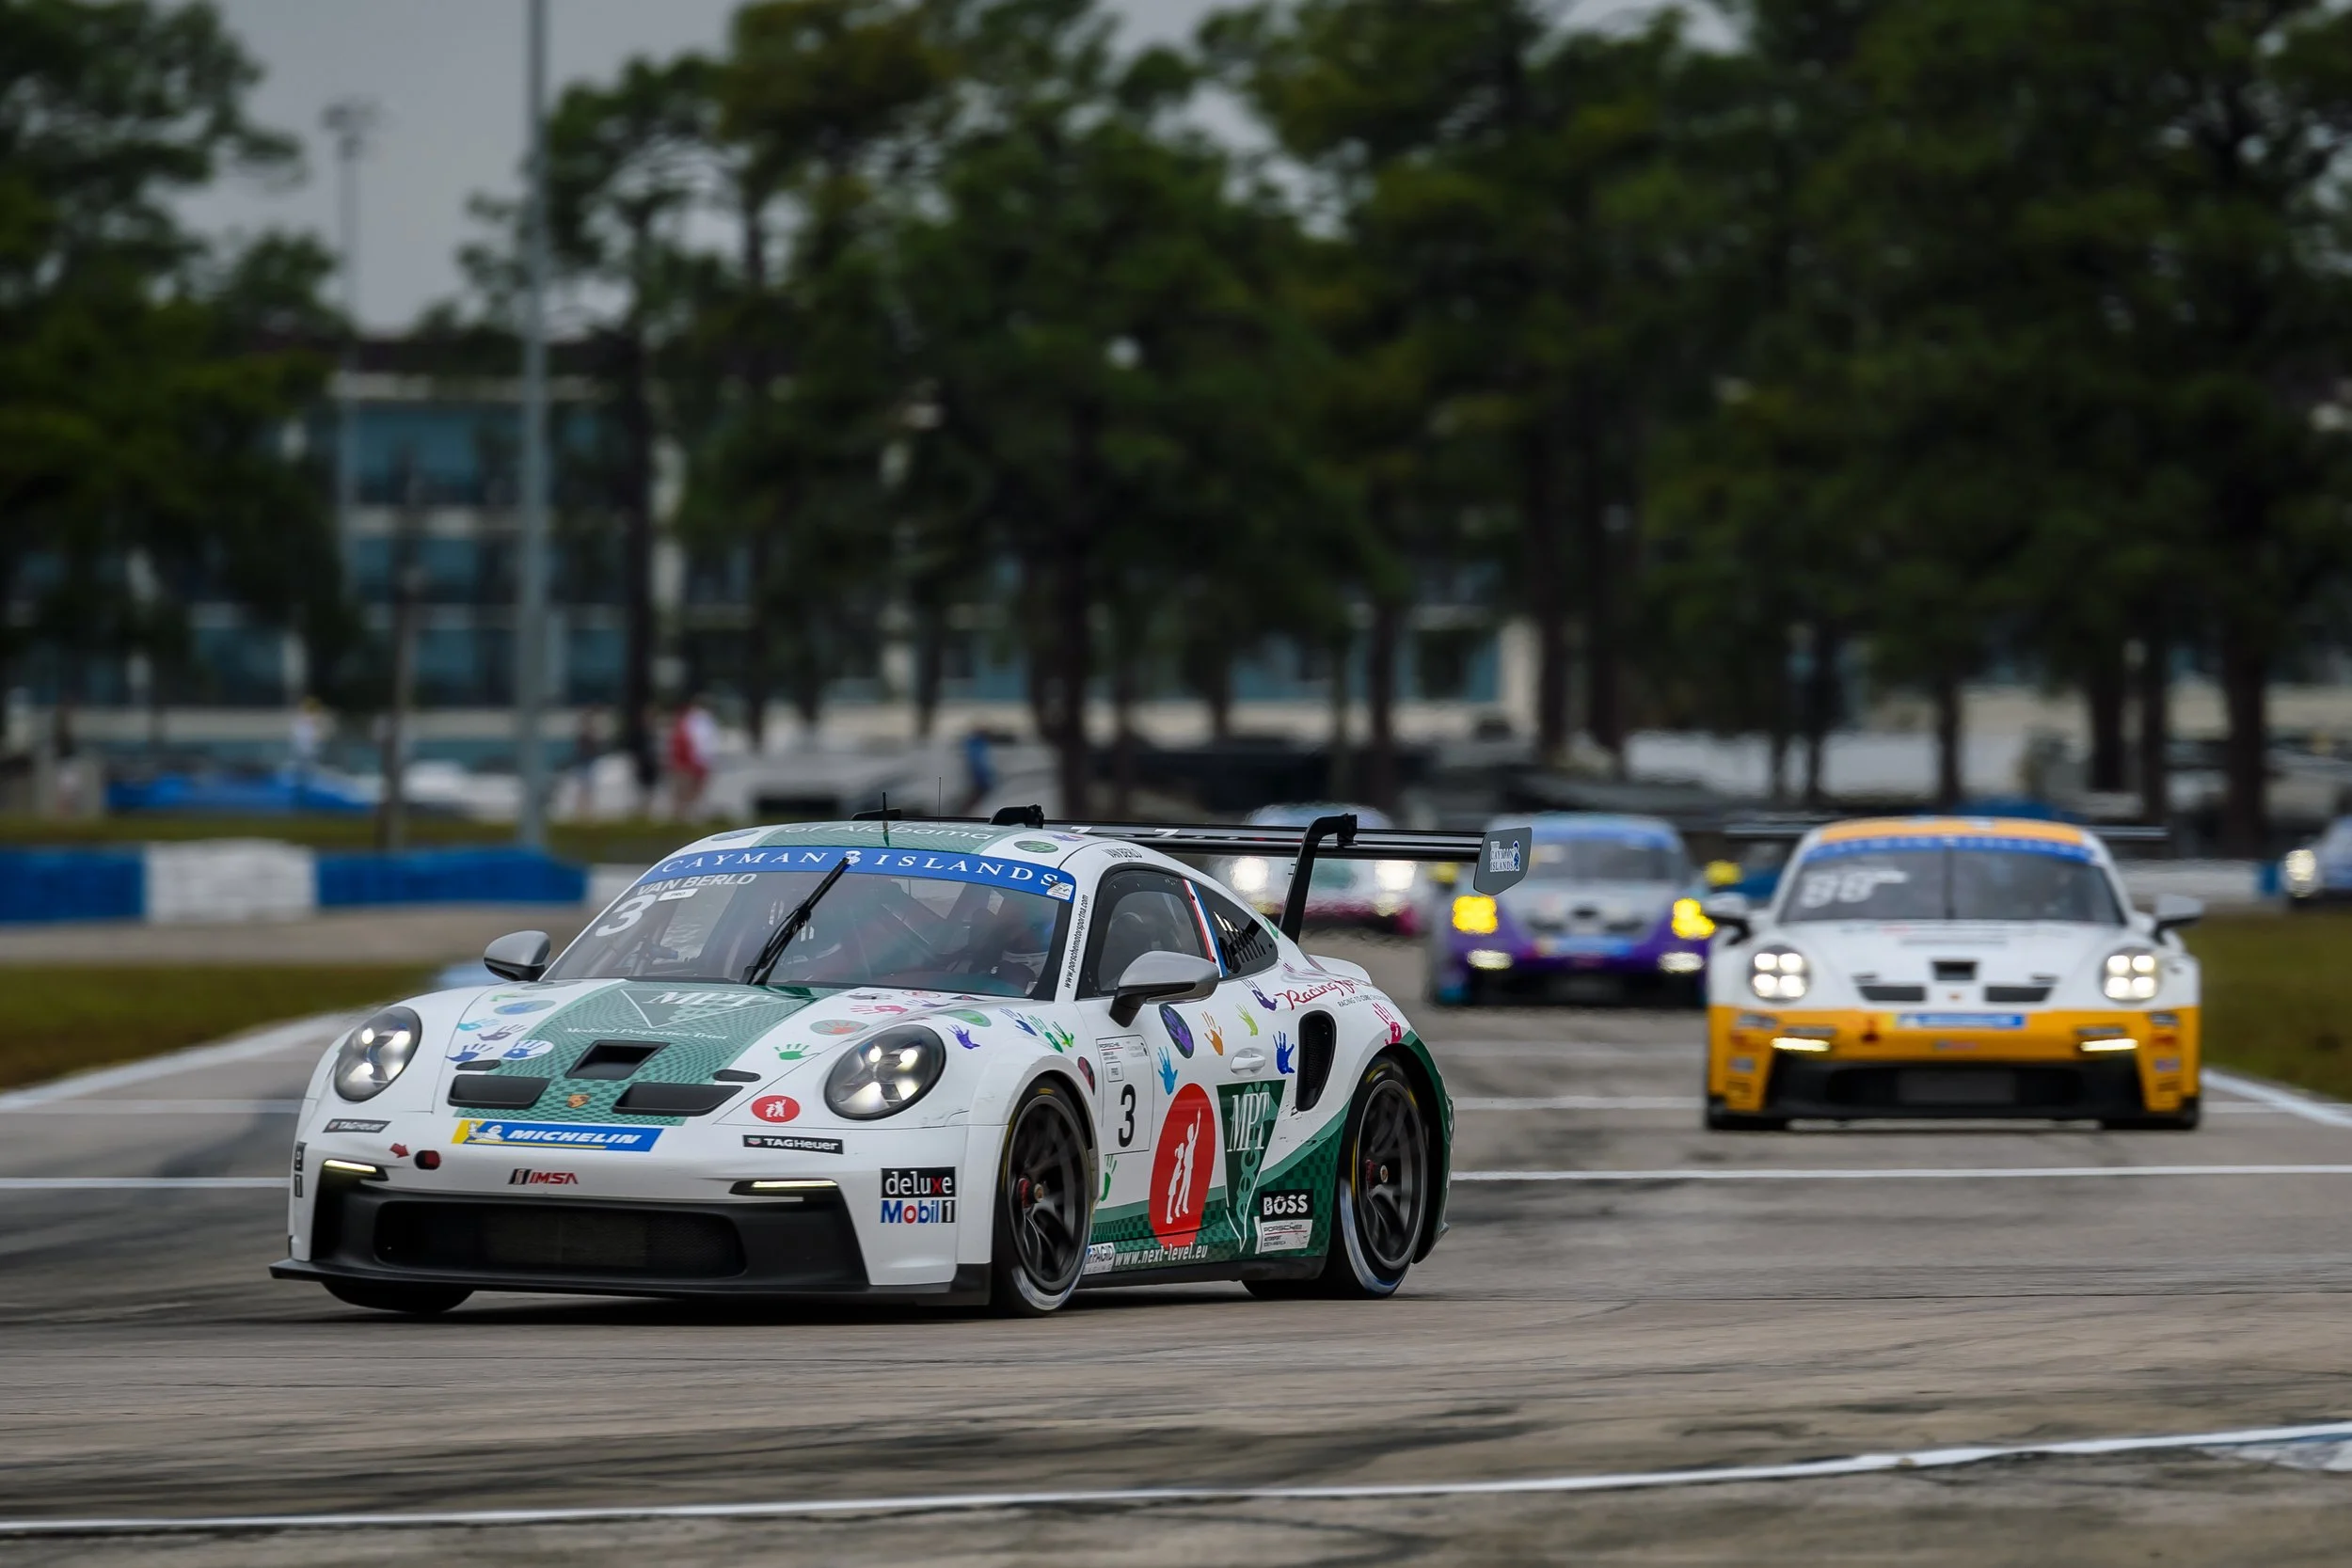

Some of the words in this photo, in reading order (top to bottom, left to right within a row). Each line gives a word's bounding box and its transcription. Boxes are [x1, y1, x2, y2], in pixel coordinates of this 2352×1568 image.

[829, 824, 993, 840] Alabama
[661, 851, 828, 873] CAYMAN
[874, 854, 1059, 887] ISLANDS
[1490, 861, 1514, 871] ISLANDS
[637, 875, 681, 896] VAN
[681, 873, 757, 889] BERLO
[596, 894, 657, 937] 3
[642, 991, 773, 1007] MPT
[1274, 979, 1344, 1011] Racing
[1118, 1084, 1136, 1148] 3
[1227, 1091, 1270, 1152] MPT
[508, 1130, 643, 1145] MICHELIN
[529, 1172, 580, 1185] IMSA
[885, 1171, 953, 1196] deluxe
[1263, 1194, 1308, 1215] BOSS
[1263, 1224, 1303, 1232] PORSCHE
[1115, 1242, 1209, 1267] www.next-level.eu
